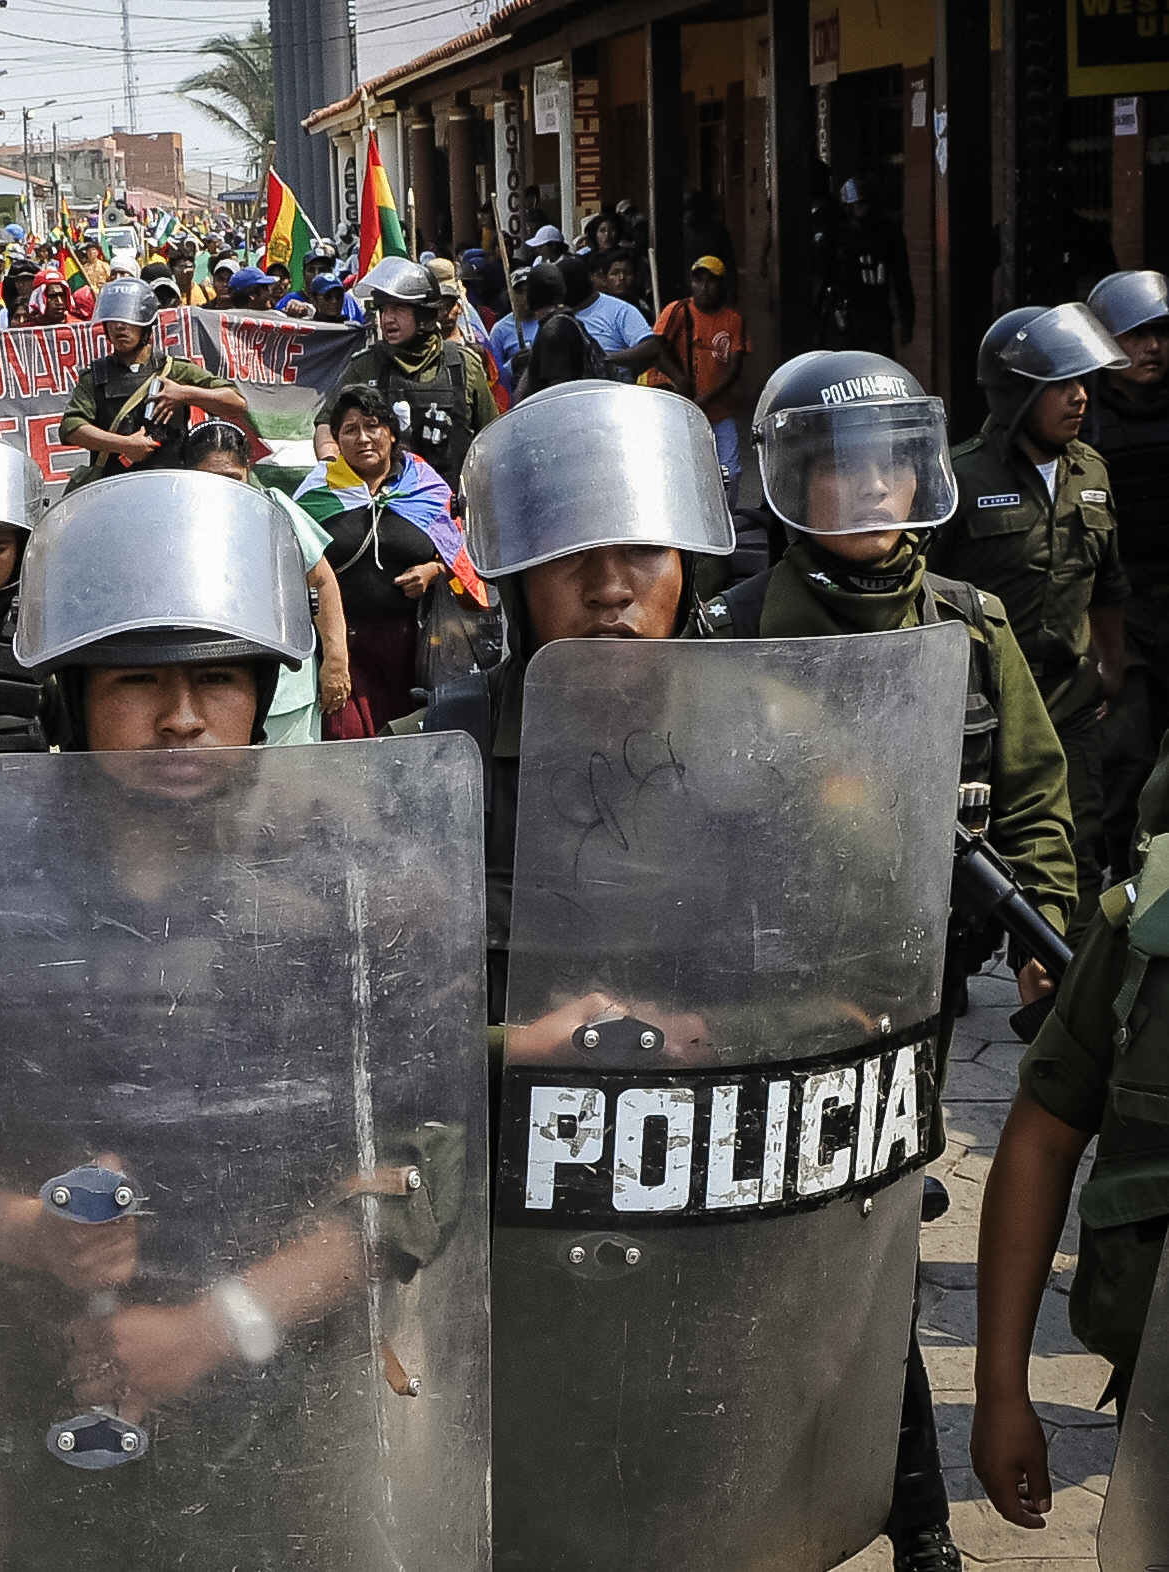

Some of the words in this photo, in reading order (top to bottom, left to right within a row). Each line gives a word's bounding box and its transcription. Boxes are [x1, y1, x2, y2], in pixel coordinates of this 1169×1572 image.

[1082, 0, 1169, 15] WES
[575, 80, 600, 214] FOTOCOP
[219, 313, 316, 384] NORTE
[821, 375, 910, 406] POLIVALENTE
[525, 1043, 921, 1212] POLICIA
